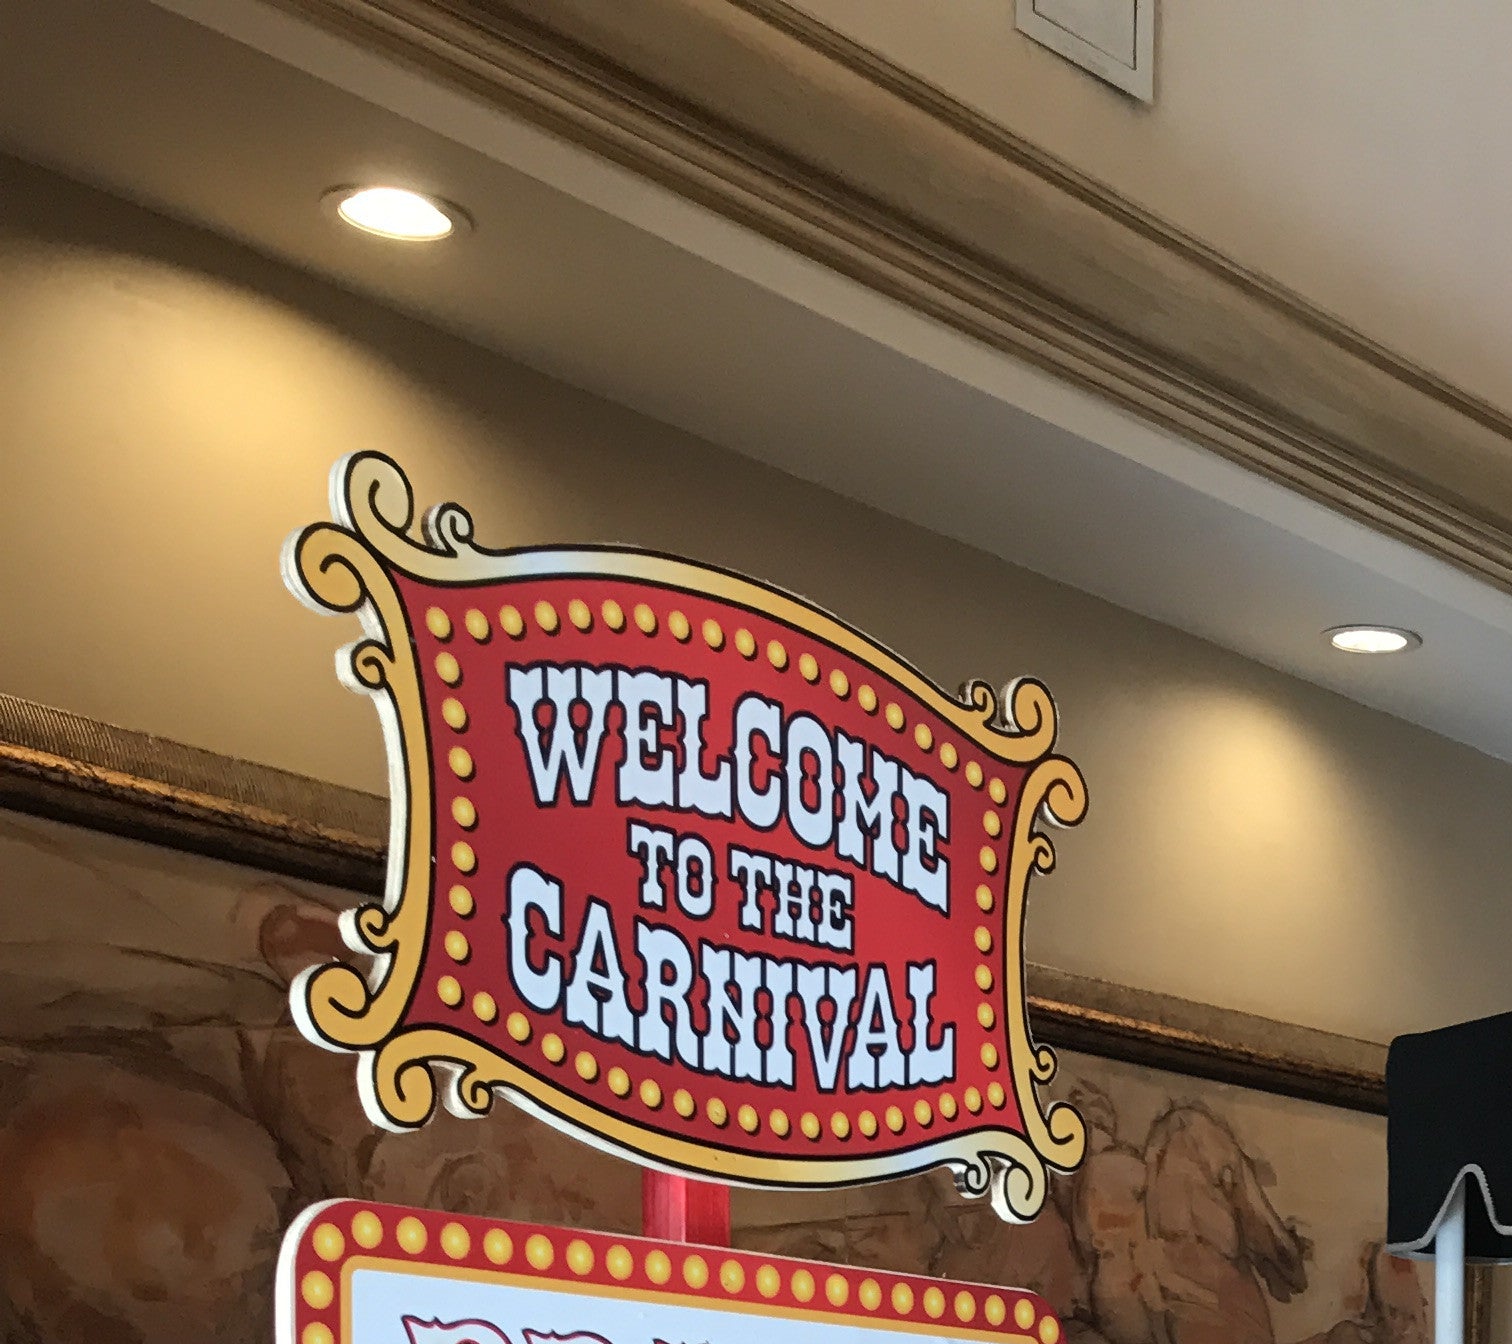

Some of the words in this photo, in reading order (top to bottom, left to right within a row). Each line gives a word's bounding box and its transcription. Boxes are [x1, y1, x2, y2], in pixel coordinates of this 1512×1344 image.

[505, 660, 951, 916] WELCOME
[628, 821, 716, 918] TO
[729, 847, 854, 952] THE
[505, 861, 957, 1092] CARNIVAL
